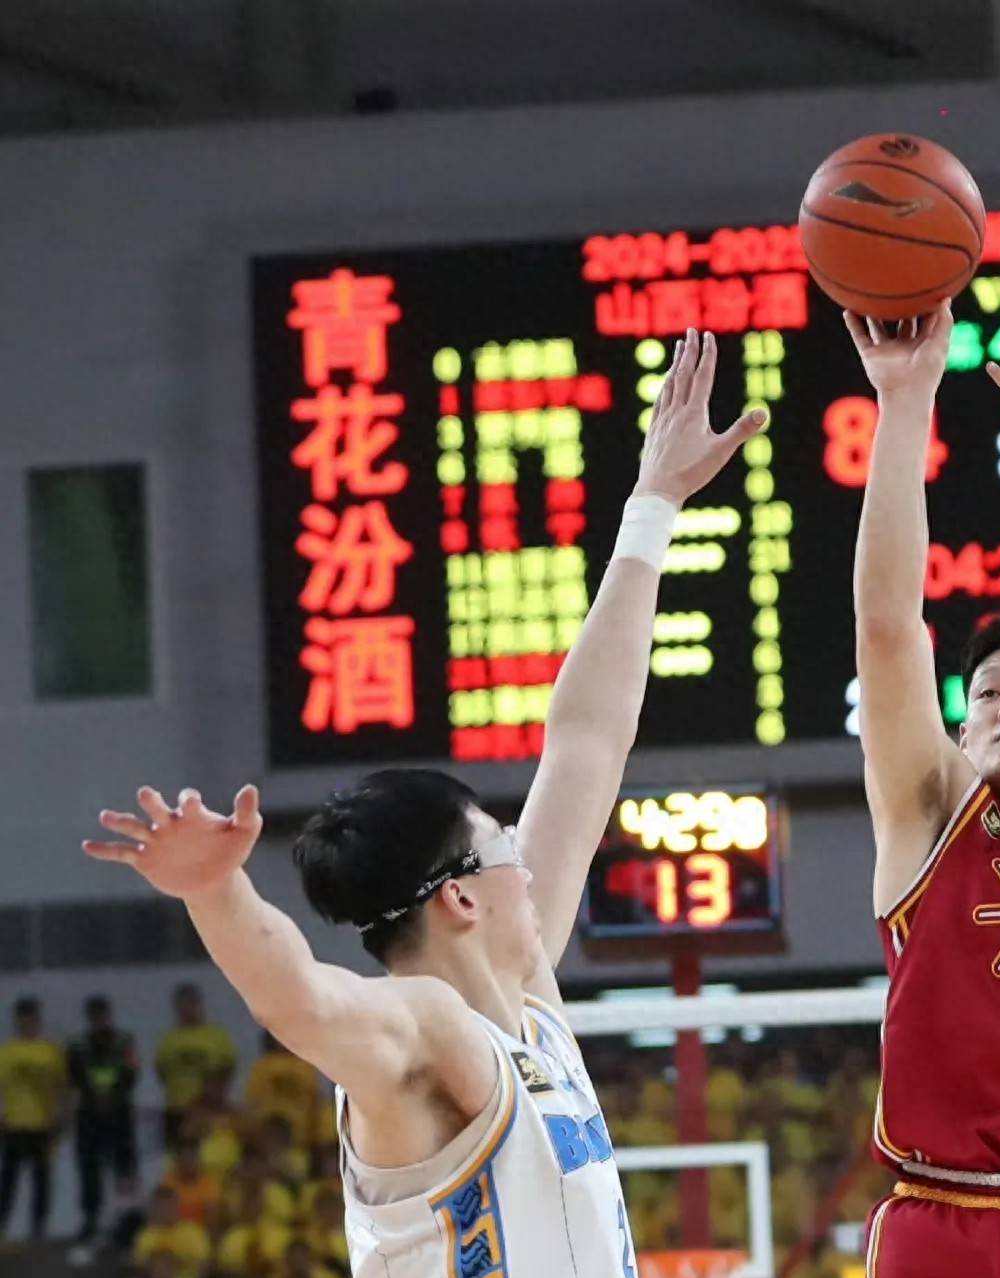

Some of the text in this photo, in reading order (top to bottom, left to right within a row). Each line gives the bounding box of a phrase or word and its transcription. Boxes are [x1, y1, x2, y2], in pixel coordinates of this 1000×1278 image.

[287, 267, 414, 733] 青花汾酒
[656, 853, 732, 927] 13
